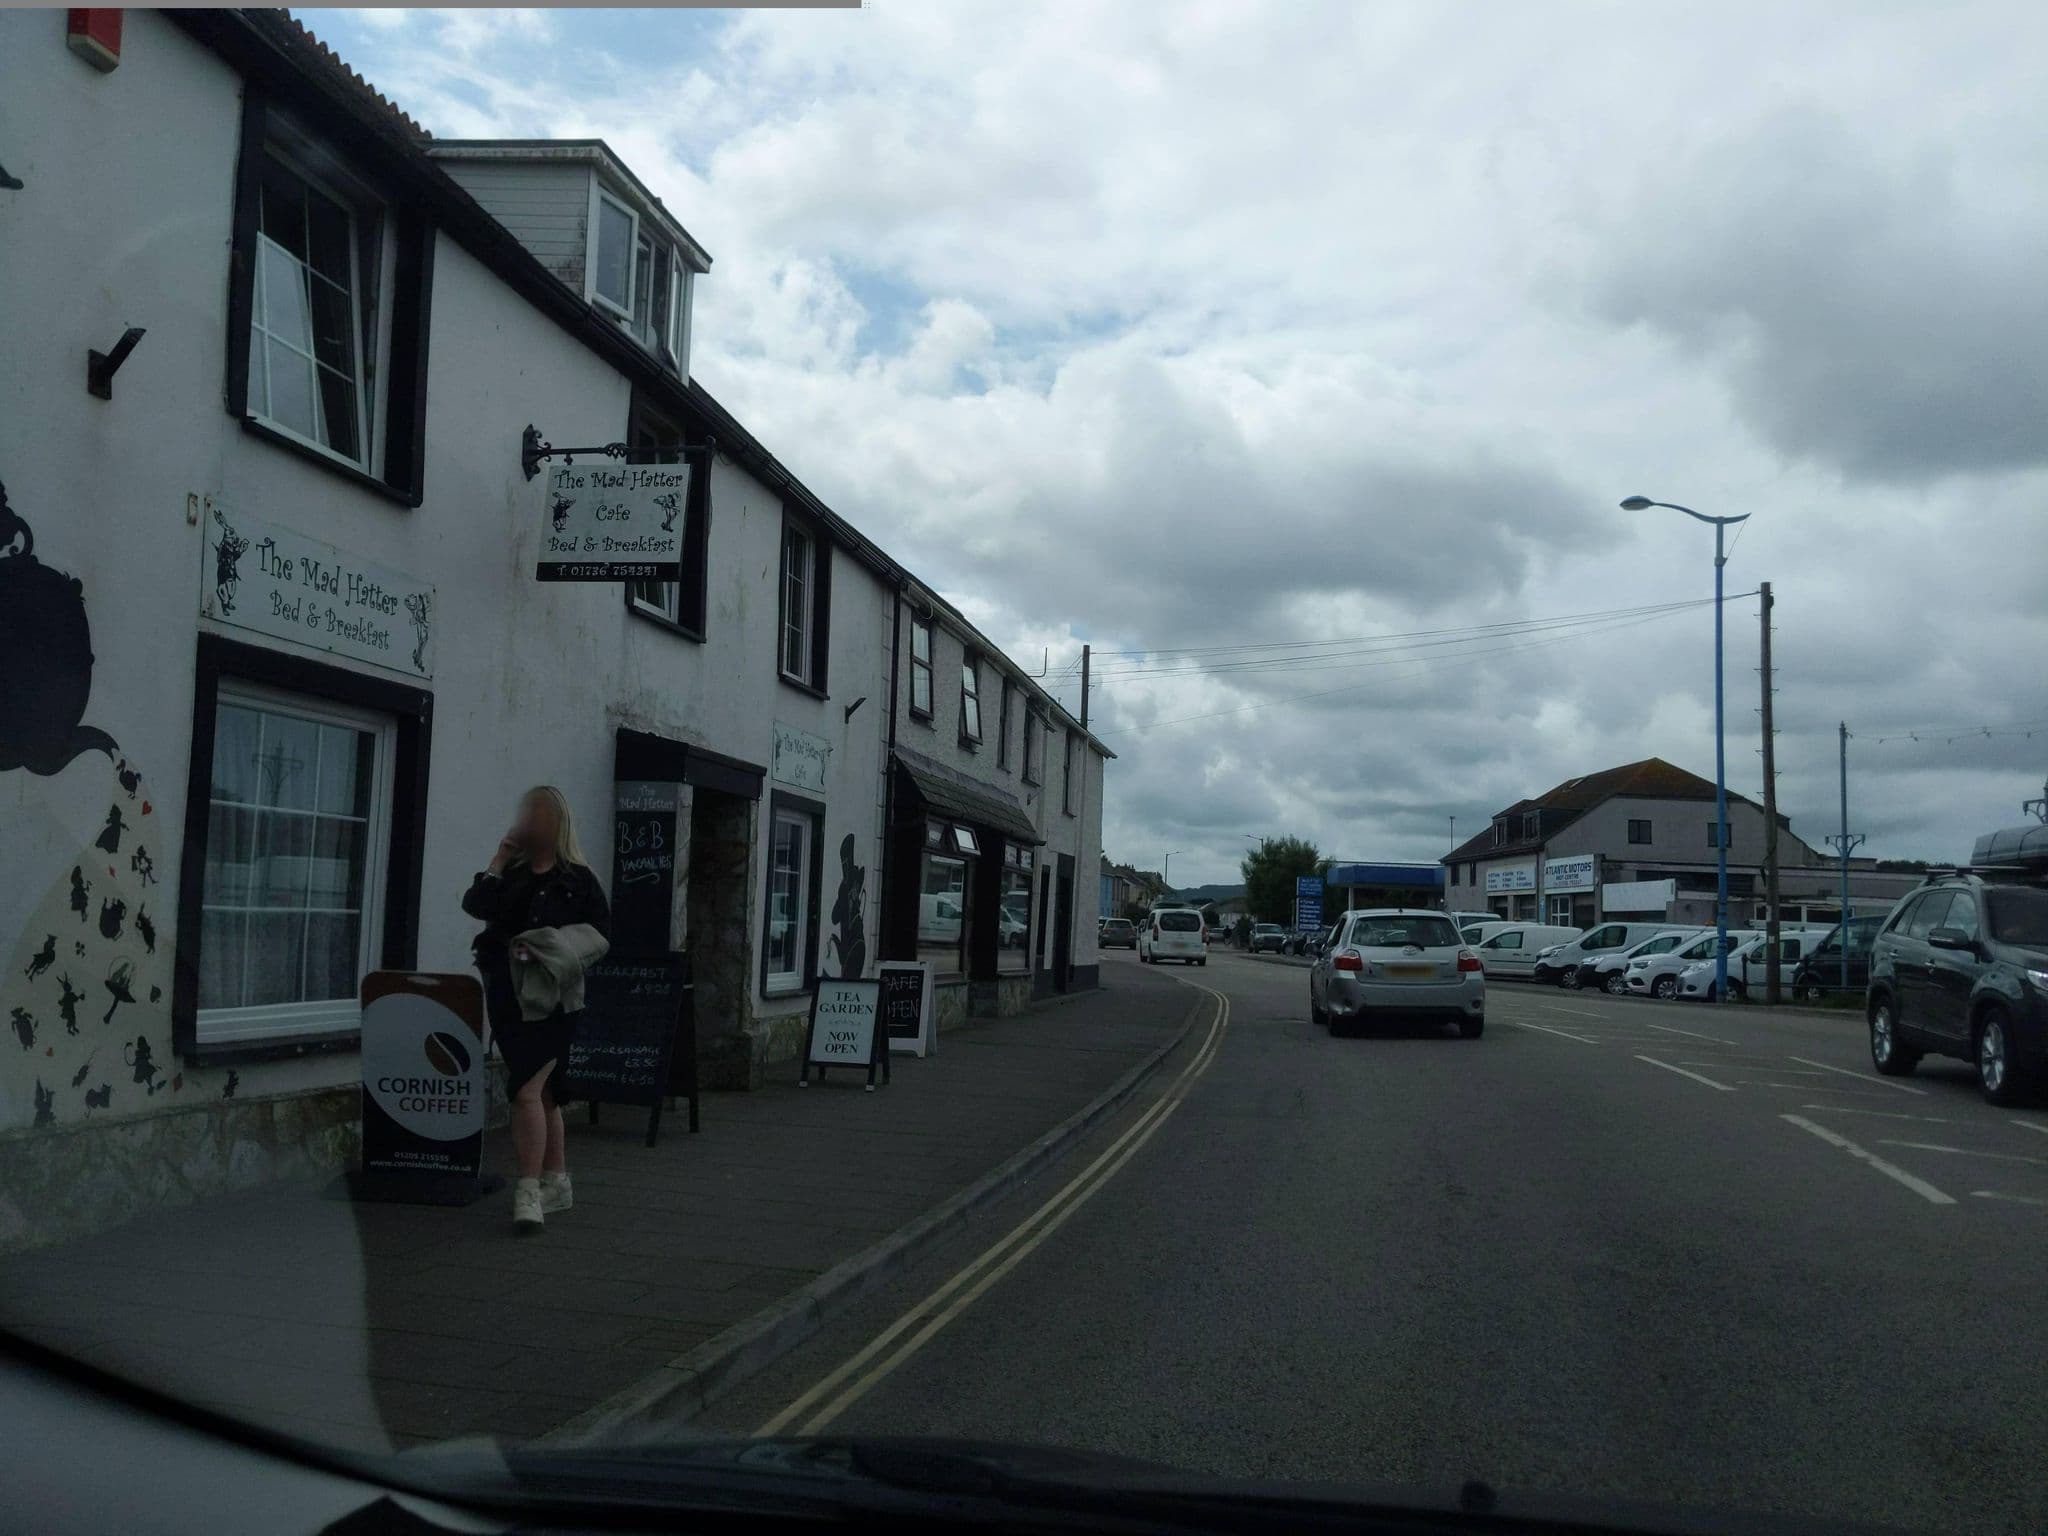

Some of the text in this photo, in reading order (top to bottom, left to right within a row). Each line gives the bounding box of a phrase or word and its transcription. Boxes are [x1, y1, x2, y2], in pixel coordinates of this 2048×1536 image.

[555, 469, 683, 491] The Mad Hatter
[596, 503, 631, 522] Cafe
[548, 535, 675, 554] Bed & Breakfast
[255, 536, 399, 616] The Mad Hatter
[269, 590, 391, 650] Bed & Breakfast
[836, 991, 860, 1002] TEA
[820, 1003, 874, 1015] GARDEN
[829, 1031, 859, 1042] NOW
[825, 1044, 858, 1054] OPEN
[378, 1077, 471, 1096] CORNISH
[399, 1096, 470, 1115] COFFEE
